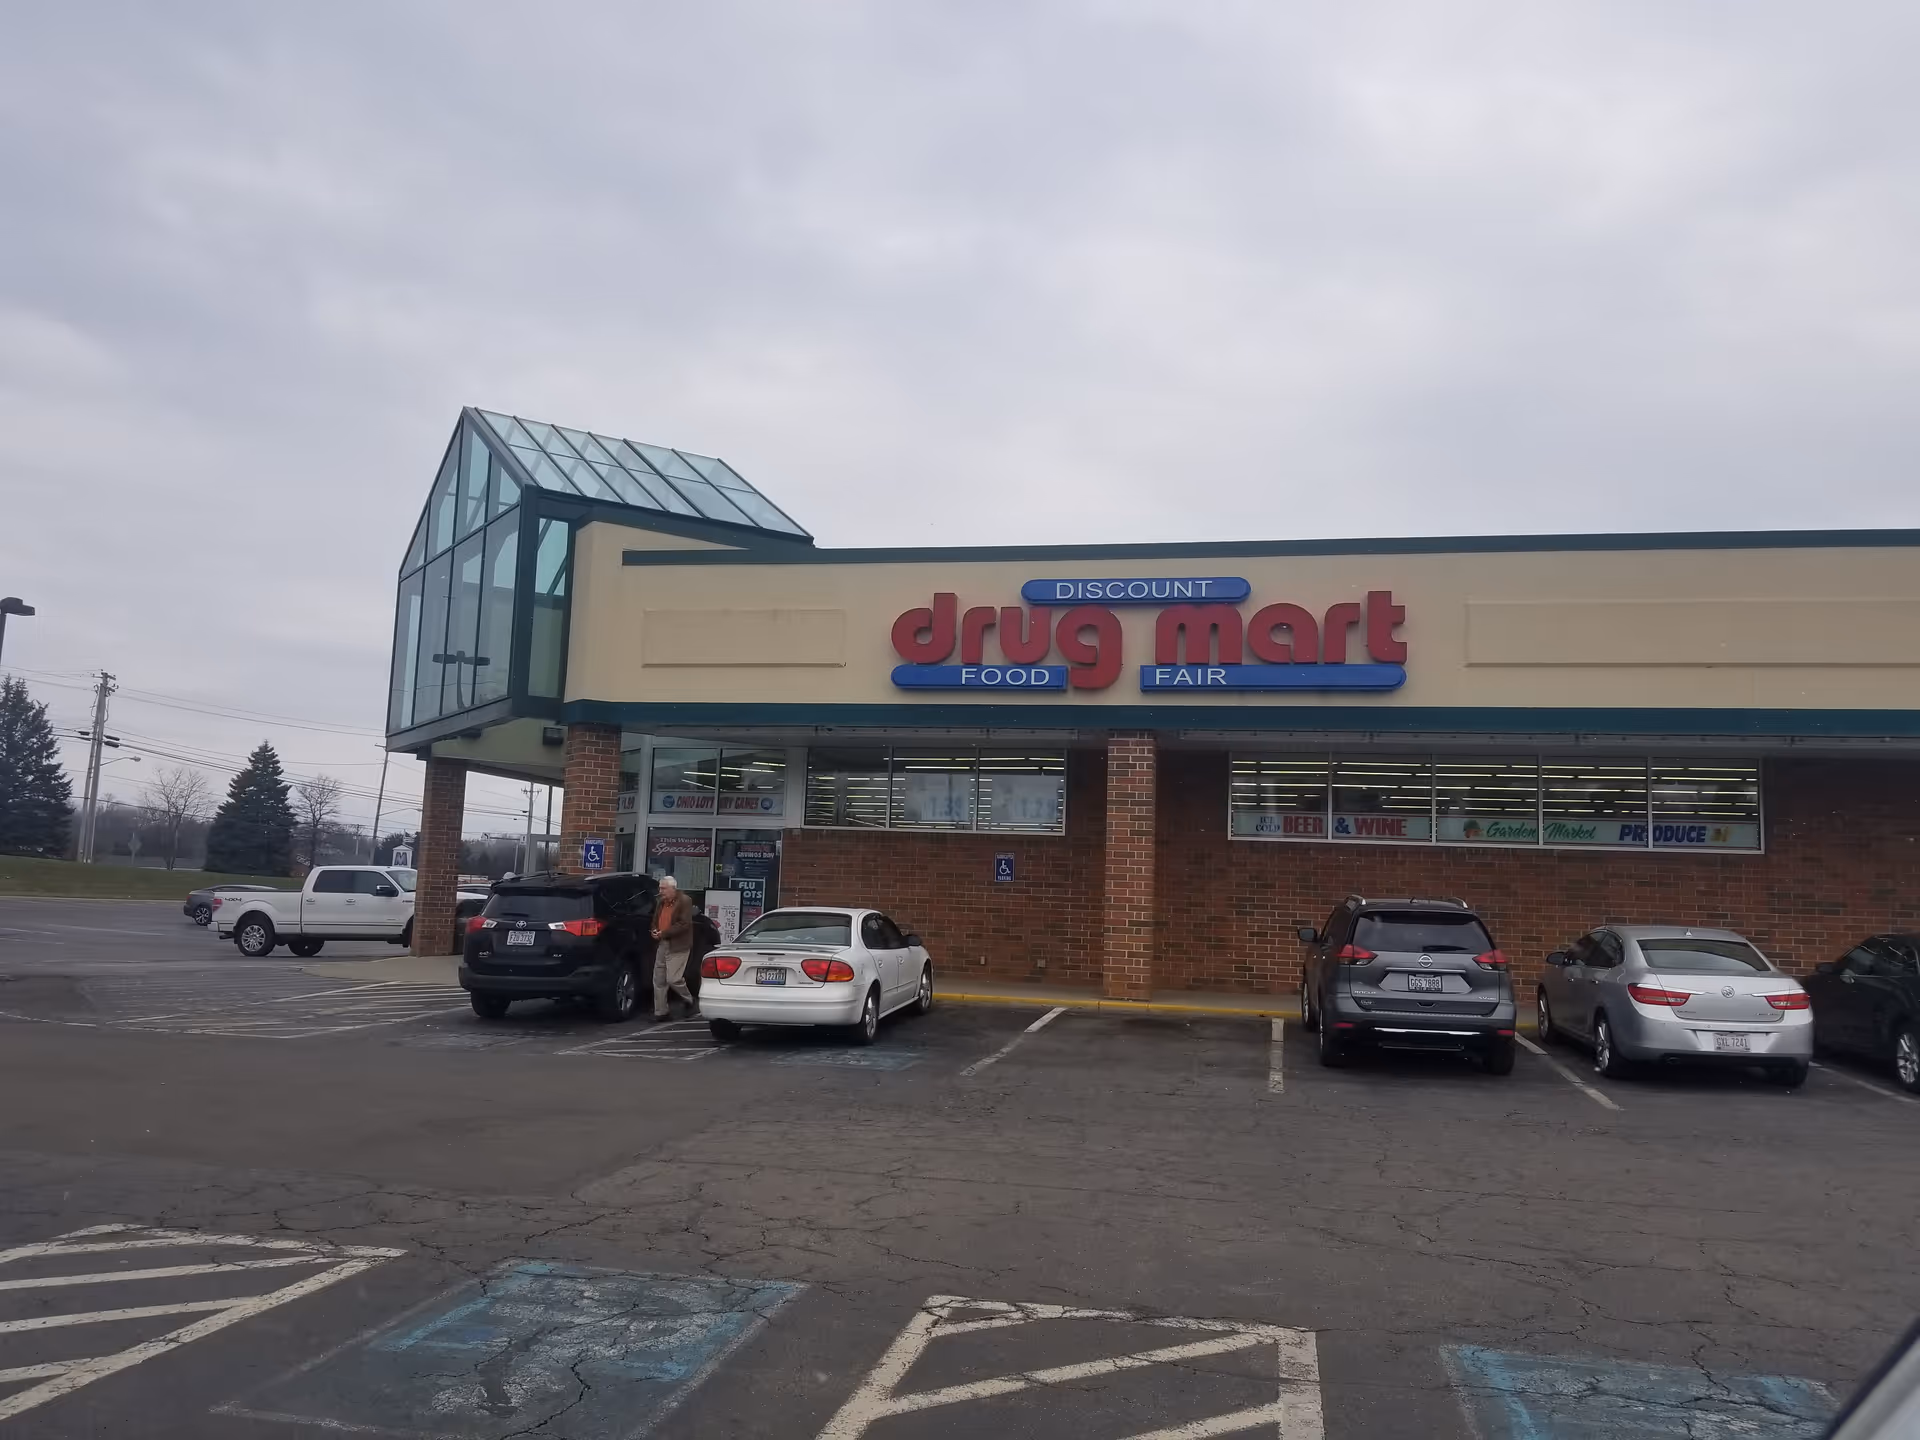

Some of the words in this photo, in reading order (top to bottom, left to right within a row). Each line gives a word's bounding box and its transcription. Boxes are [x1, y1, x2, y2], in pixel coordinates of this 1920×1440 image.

[1055, 580, 1213, 599] DISCOUNT
[891, 593, 1123, 689] drug
[1155, 590, 1407, 665] mart
[960, 668, 1050, 686] FOOD
[1154, 668, 1228, 686] FAIR
[676, 796, 696, 809] OHIO
[697, 796, 732, 809] LOTTRY
[734, 797, 759, 810] GAMES
[1255, 823, 1281, 833] COLD
[1283, 815, 1324, 834] BEER
[1334, 817, 1351, 835] &
[1353, 817, 1408, 836] WINE
[1486, 821, 1537, 839] Garden
[1543, 823, 1597, 840] Market
[651, 843, 710, 856] Specials
[738, 881, 756, 889] FLU
[1410, 978, 1422, 987] GGS
[1731, 1037, 1748, 1048] 7241
